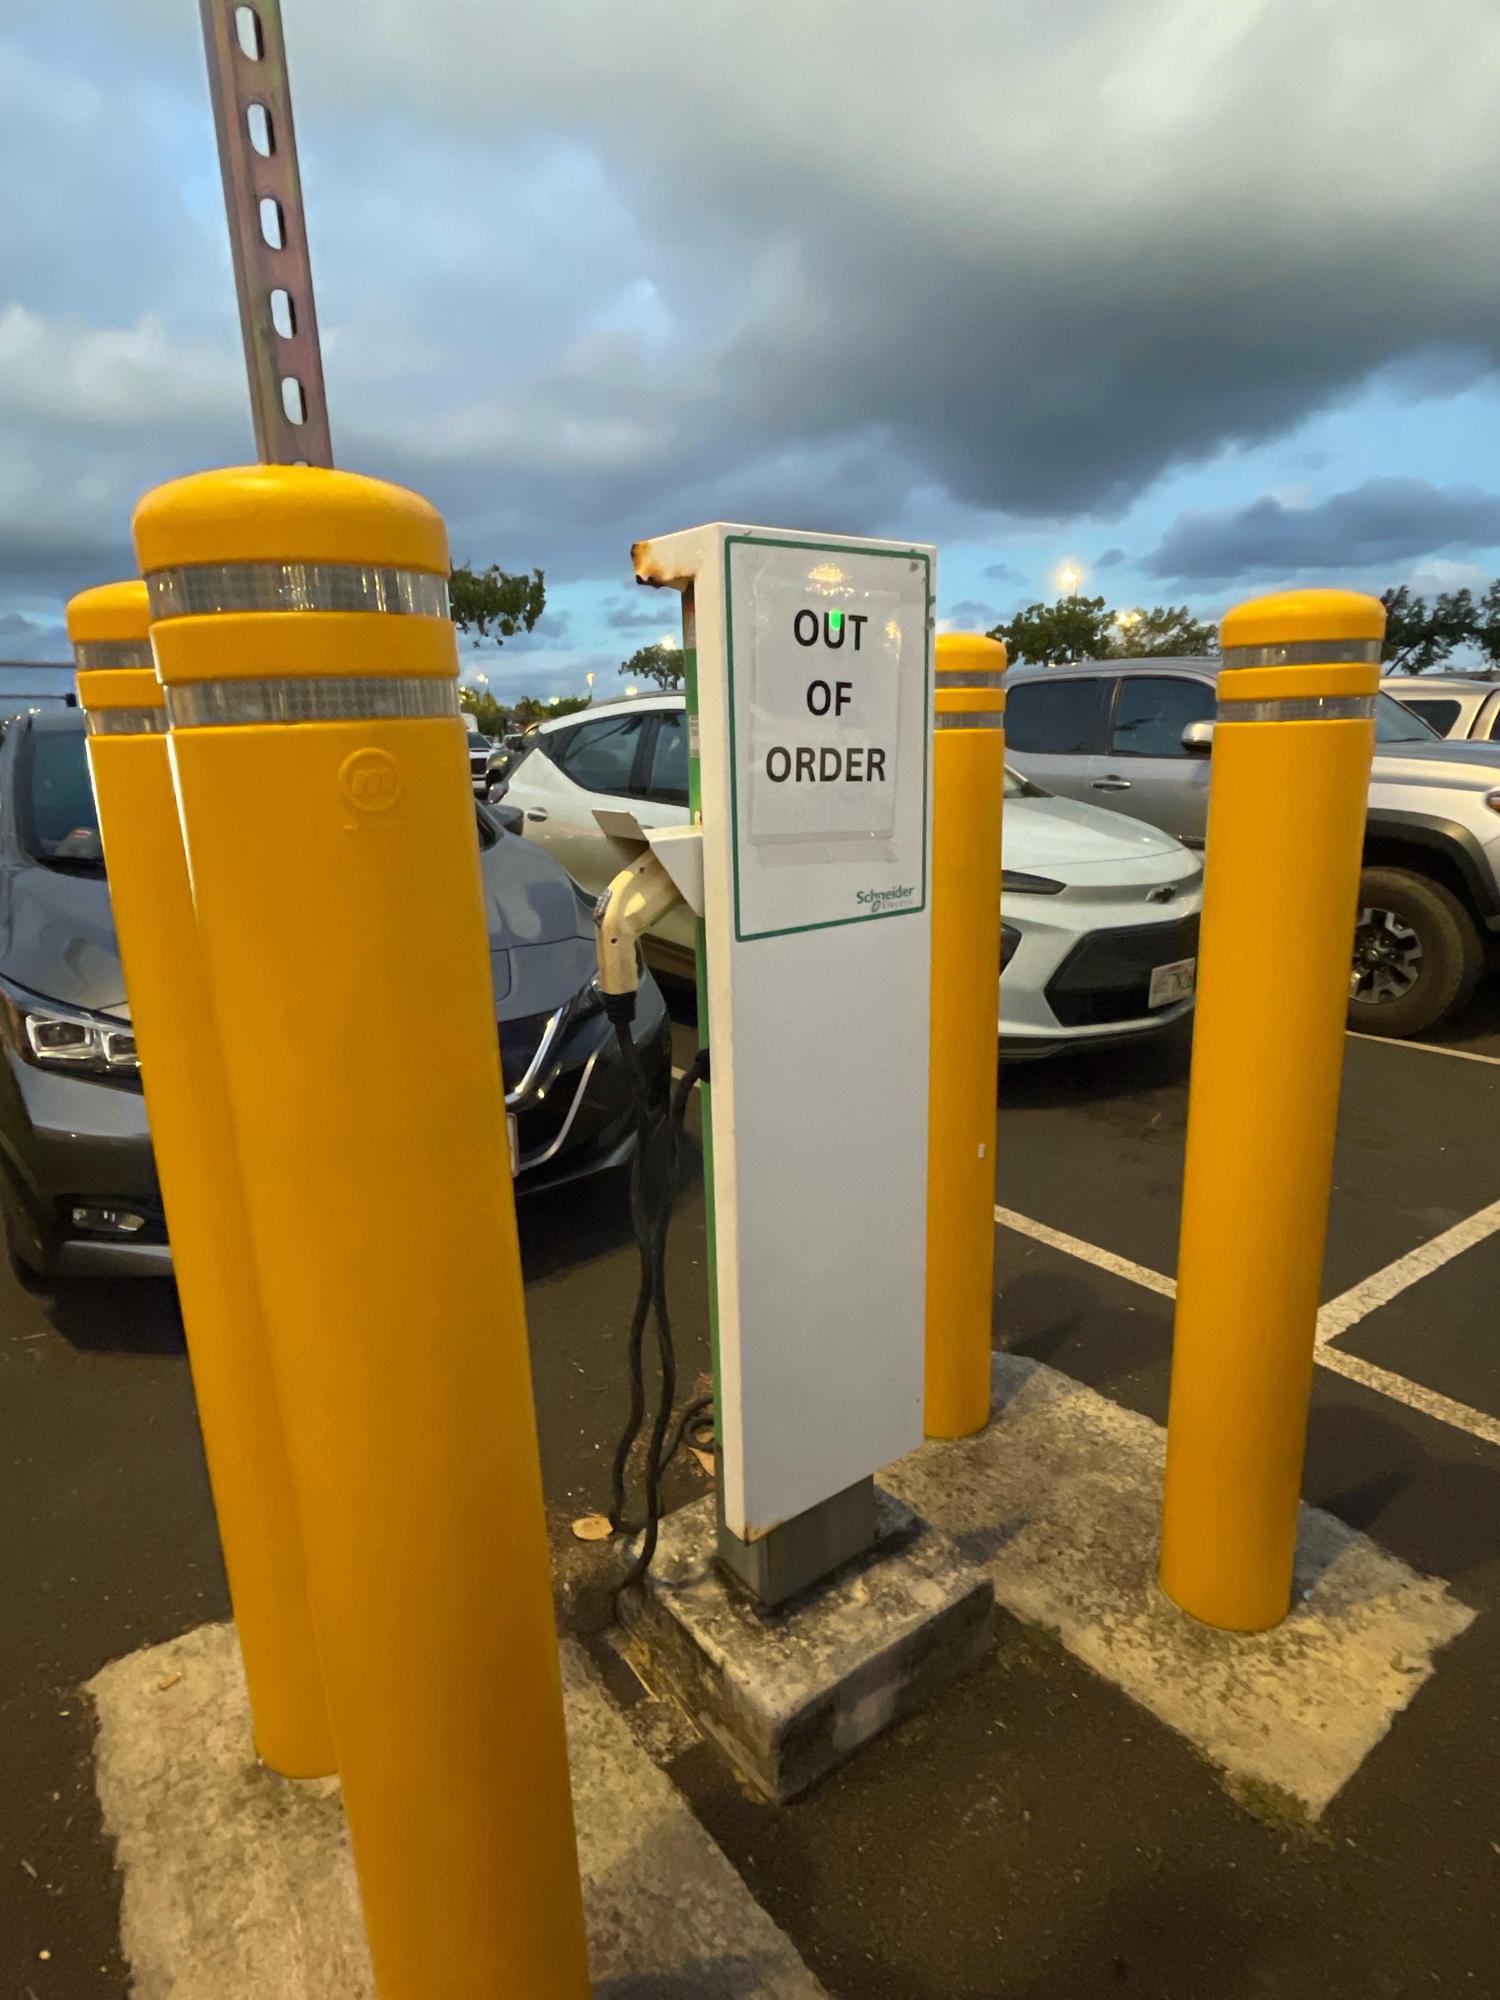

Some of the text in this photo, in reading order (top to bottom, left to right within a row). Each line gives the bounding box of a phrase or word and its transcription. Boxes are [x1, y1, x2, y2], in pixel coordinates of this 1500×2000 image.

[793, 609, 868, 651] OUT
[806, 680, 852, 716] OF
[765, 746, 886, 783] ORDER
[856, 885, 915, 904] Schneider
